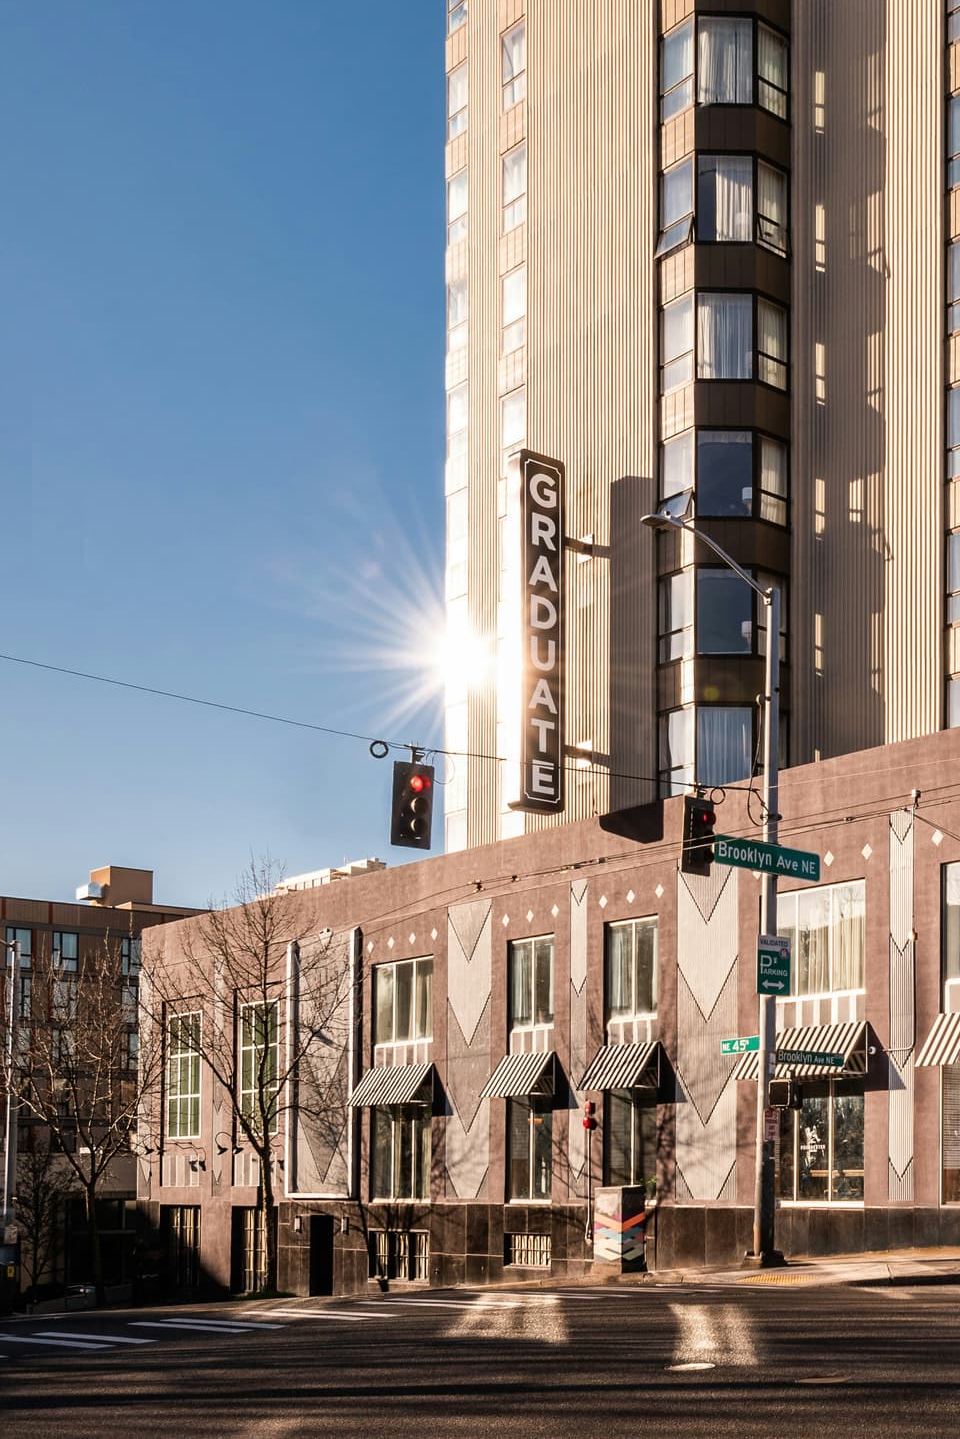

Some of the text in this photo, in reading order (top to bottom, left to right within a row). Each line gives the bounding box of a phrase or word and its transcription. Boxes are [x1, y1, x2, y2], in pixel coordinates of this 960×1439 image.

[528, 473, 559, 796] GRADUATE
[718, 842, 816, 875] Brooklyn Ave NE
[760, 938, 788, 948] VALIDATED
[722, 1042, 731, 1051] NE
[778, 1050, 812, 1064] Brooklyn
[814, 1056, 825, 1064] Ave
[826, 1057, 835, 1065] NE
